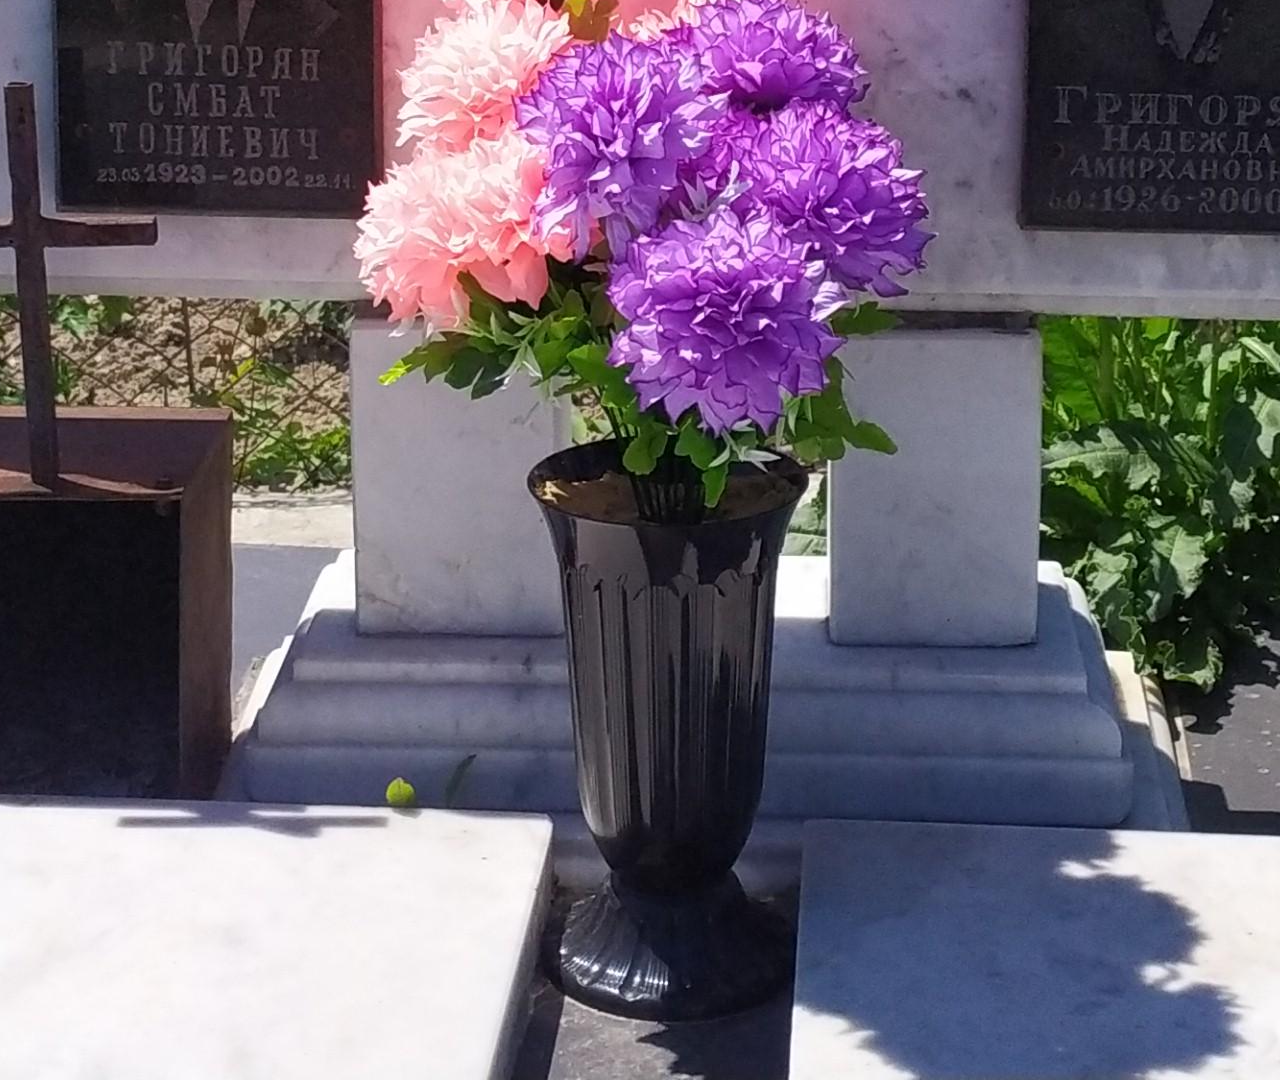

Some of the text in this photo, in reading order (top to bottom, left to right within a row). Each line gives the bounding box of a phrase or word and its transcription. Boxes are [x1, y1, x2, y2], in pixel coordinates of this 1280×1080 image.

[106, 40, 320, 81] ГРИГОРЯН
[147, 82, 281, 119] СМБАТ
[108, 122, 320, 160] ТОНИЕВИЧ
